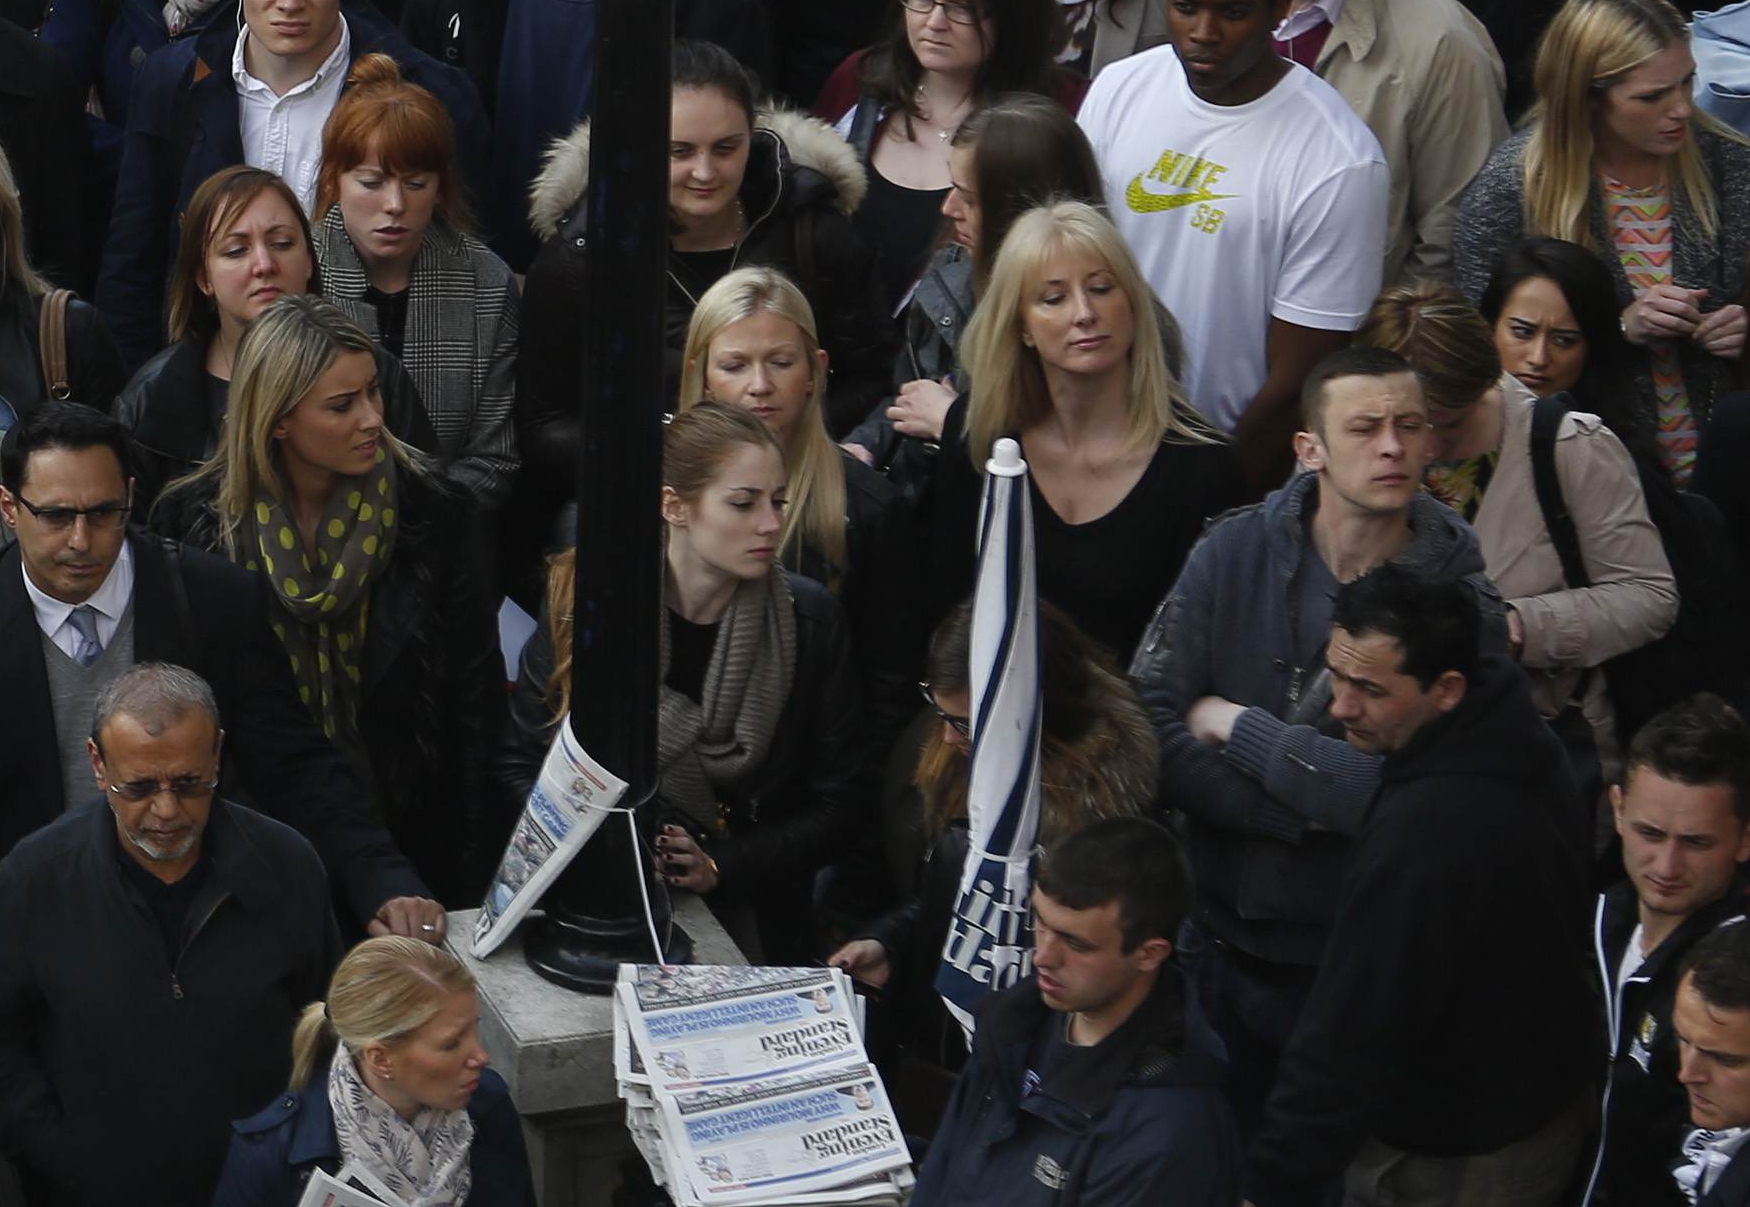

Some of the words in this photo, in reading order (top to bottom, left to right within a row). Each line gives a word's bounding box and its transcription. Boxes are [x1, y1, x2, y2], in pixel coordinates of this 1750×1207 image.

[1147, 148, 1228, 197] NIKE
[1190, 203, 1227, 234] SB
[759, 1017, 849, 1051] Standard
[774, 1030, 853, 1061] Evening
[800, 1114, 891, 1149] Standard
[815, 1127, 896, 1159] Evening
